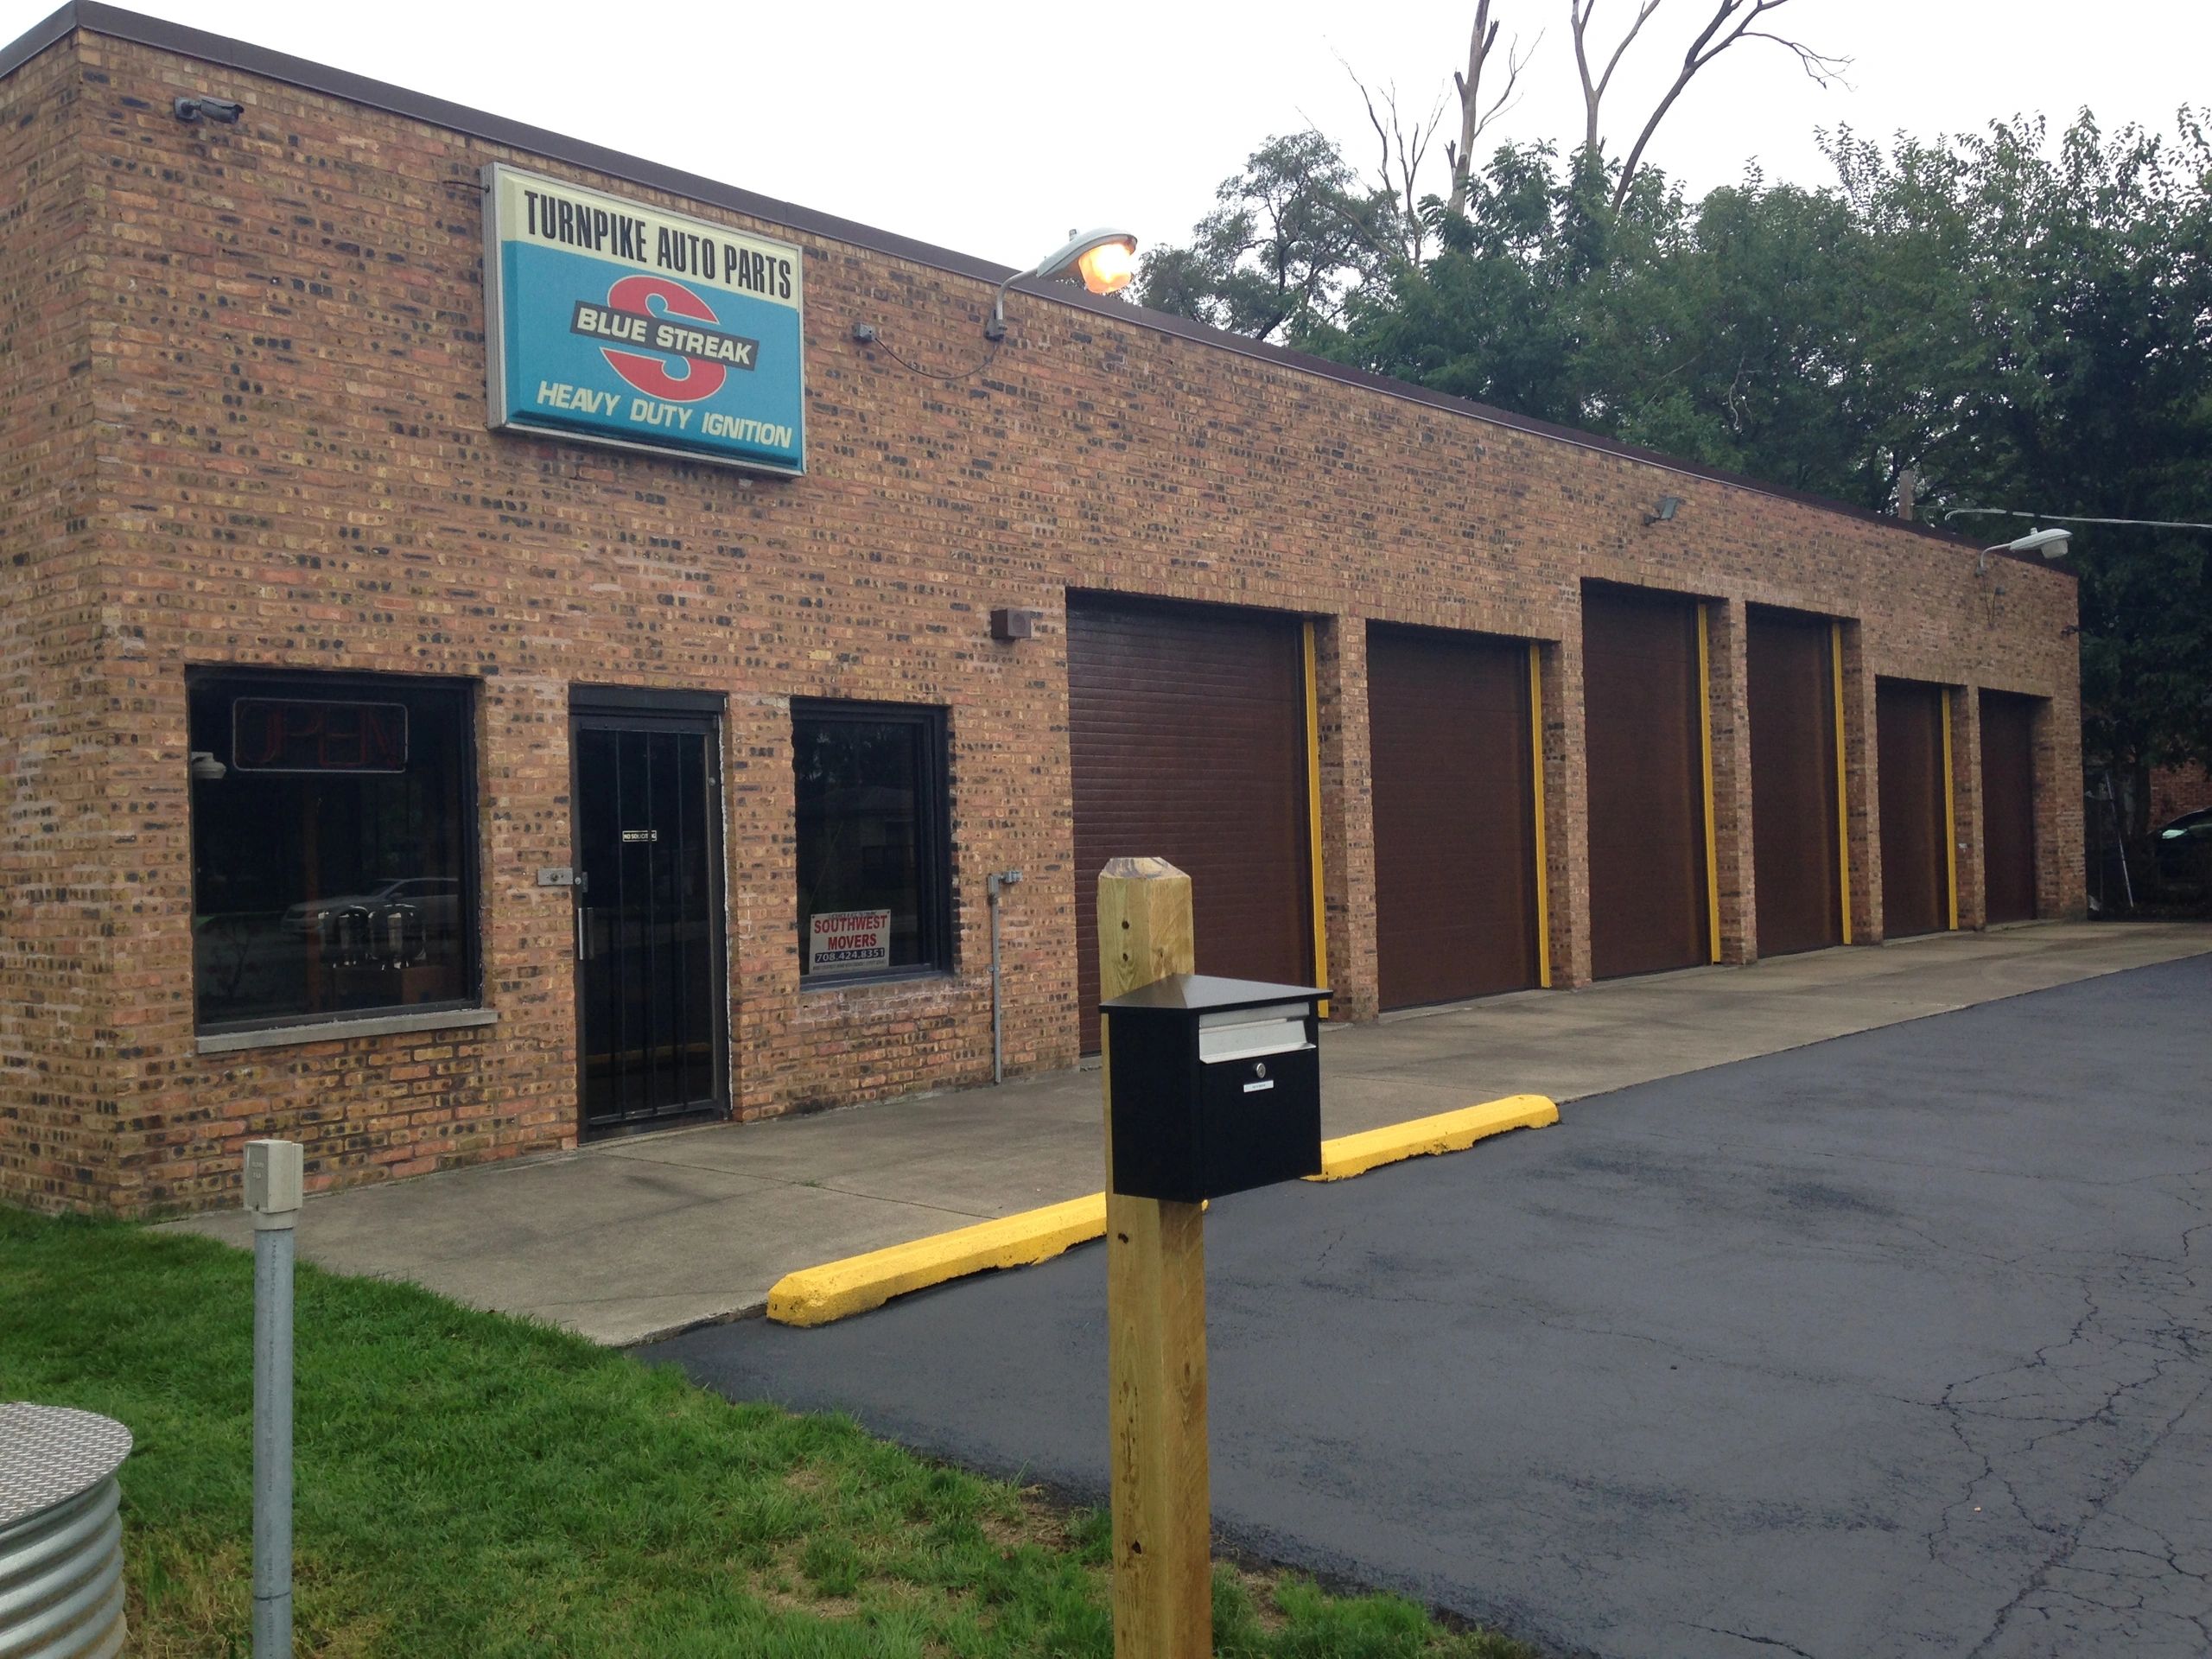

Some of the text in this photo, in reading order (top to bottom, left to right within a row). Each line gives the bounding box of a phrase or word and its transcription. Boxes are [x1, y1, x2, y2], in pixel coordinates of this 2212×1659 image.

[524, 190, 791, 300] TURNPIKE AUTO PARTS
[576, 308, 753, 365] BLUE STREAK
[537, 380, 792, 448] HEAVY DUTY IGNITION
[814, 915, 887, 933] SOUTHWEST
[828, 933, 877, 950] MOVERS
[817, 949, 884, 962] 708.424.8351
